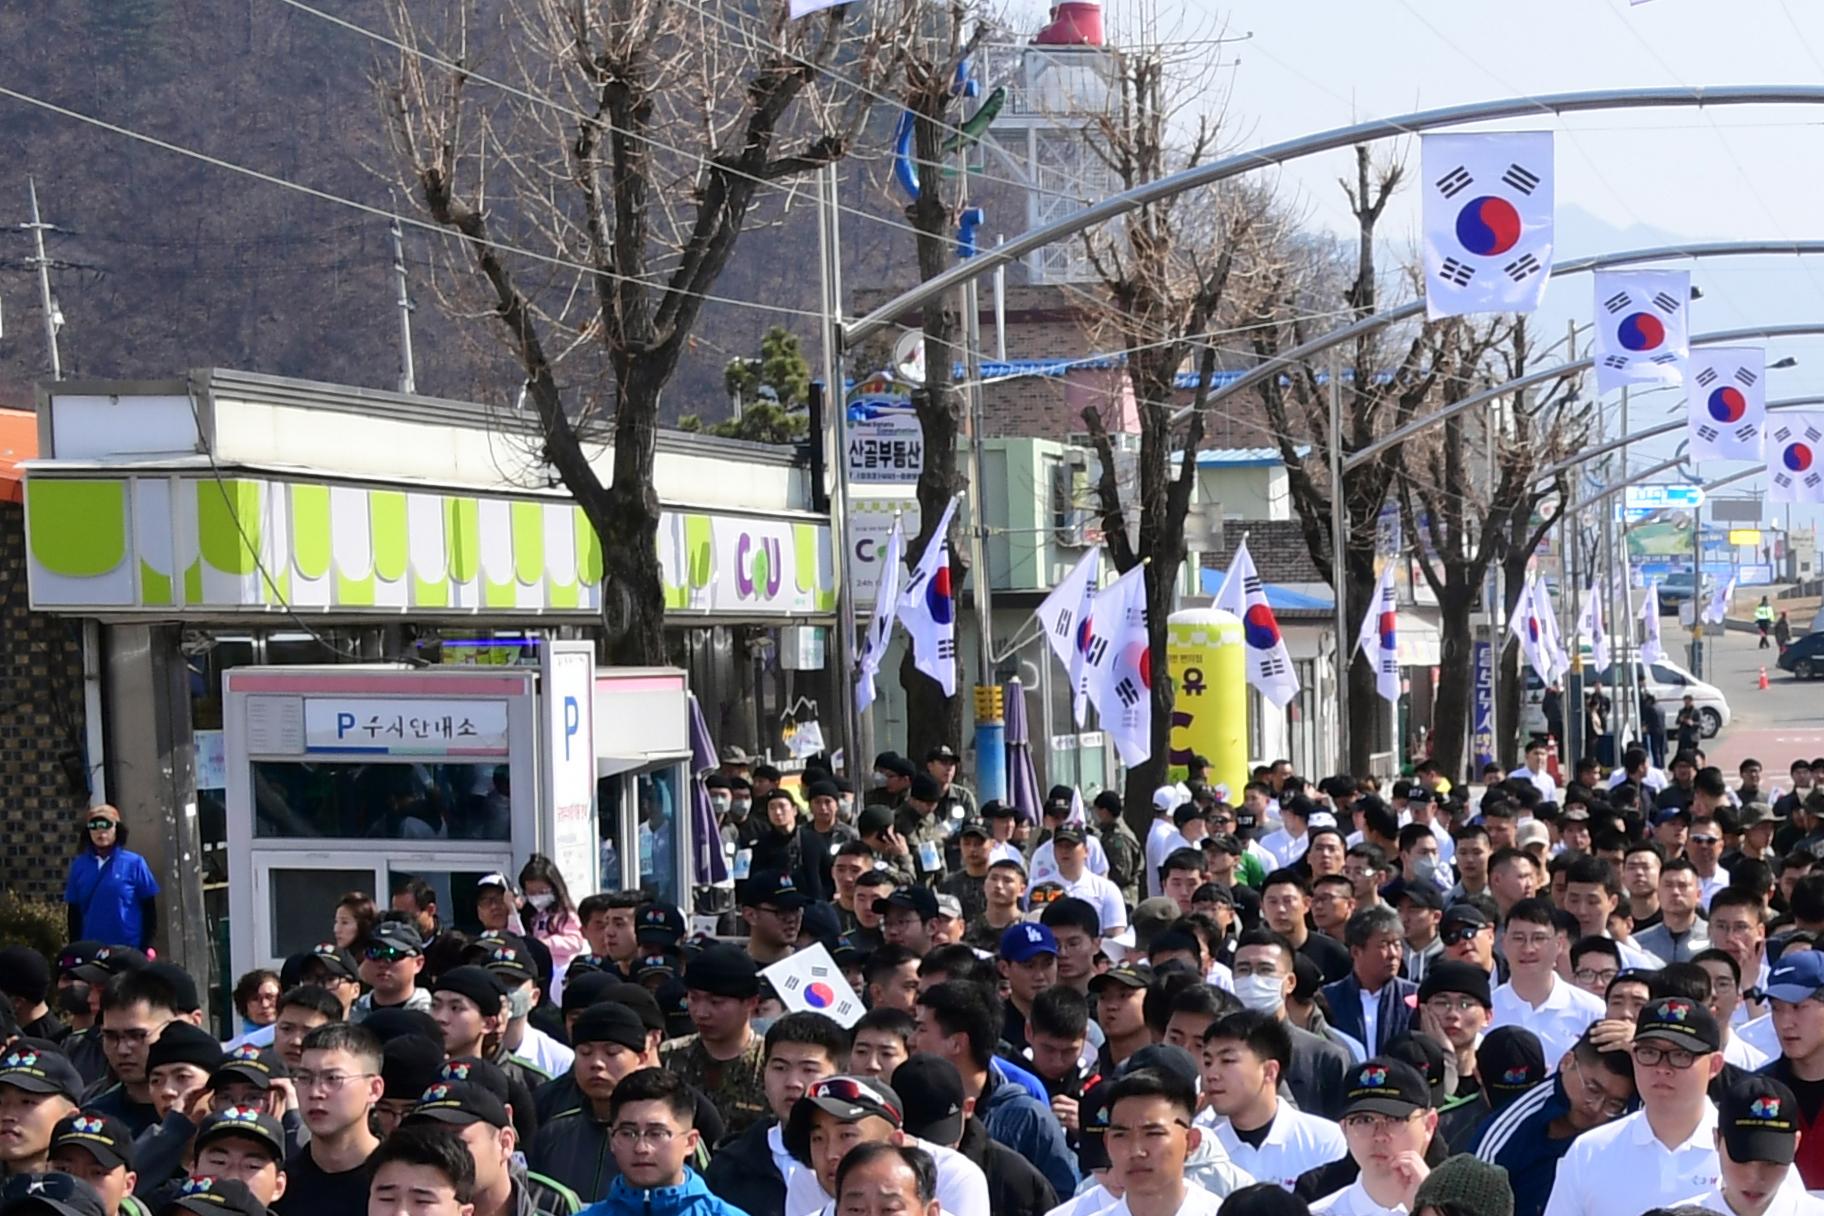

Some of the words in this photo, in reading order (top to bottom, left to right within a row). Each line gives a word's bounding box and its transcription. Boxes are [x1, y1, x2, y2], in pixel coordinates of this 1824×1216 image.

[849, 439, 921, 469] 산골부동산
[1181, 667, 1207, 696] 유
[337, 712, 356, 740] P
[564, 696, 579, 762] P
